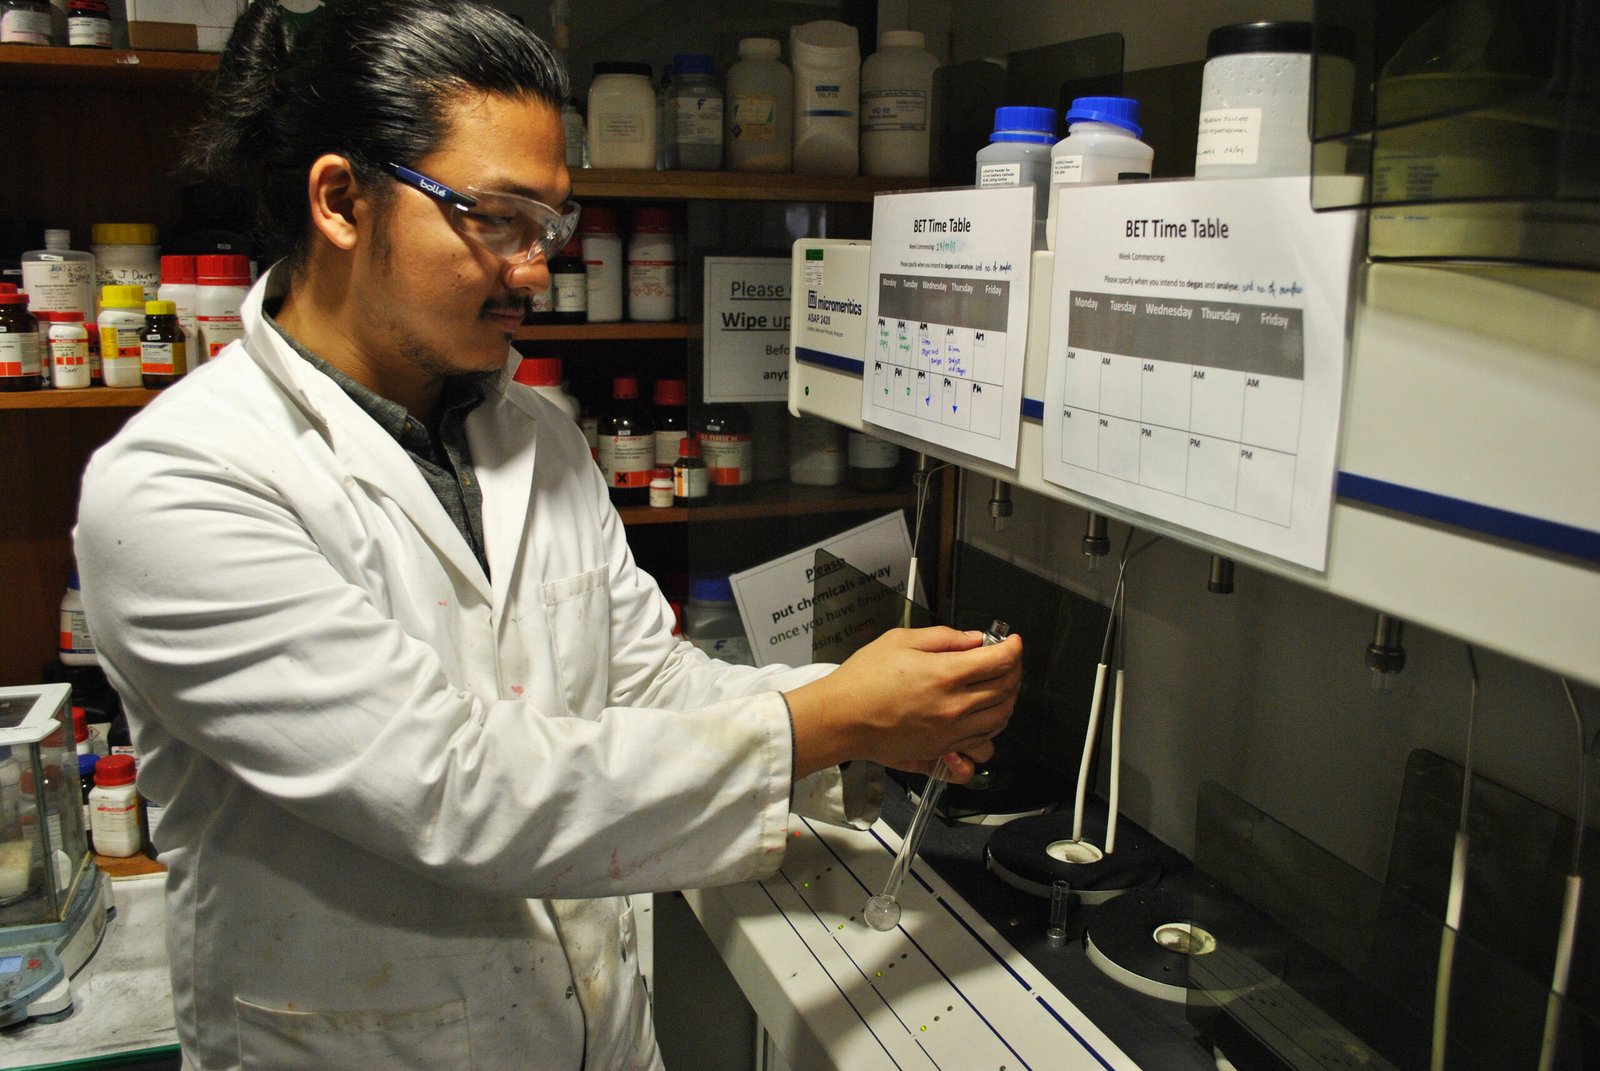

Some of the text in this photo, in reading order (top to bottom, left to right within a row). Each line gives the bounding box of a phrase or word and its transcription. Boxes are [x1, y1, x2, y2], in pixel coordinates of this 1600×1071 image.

[419, 178, 446, 198] bollé
[913, 217, 971, 233] BET Time Table
[1125, 217, 1229, 239] BET Time Table
[1118, 252, 1165, 263] Week Commencing:
[731, 281, 785, 297] Please
[882, 278, 1002, 297] Monday Tuesday Wednesday Thursday Friday
[1104, 275, 1118, 284] Please
[1118, 276, 1134, 286] specify
[1135, 278, 1148, 286] when
[1149, 279, 1159, 287] you
[1160, 279, 1178, 288] intend
[1179, 280, 1186, 288] to
[1186, 280, 1203, 291] degas
[817, 295, 862, 316] micromeritics
[1074, 296, 1289, 330] Monday Tuesday Wednesday Thursday Friday
[722, 312, 791, 329] Wipe up
[808, 313, 831, 325] ASAP 2420
[919, 322, 928, 331] AM
[975, 332, 985, 341] AM
[1067, 352, 1259, 388] AM AM AM AM AM
[895, 368, 903, 378] PM
[918, 371, 926, 379] PM
[944, 378, 952, 388] PM
[972, 383, 982, 394] PM
[1063, 410, 1253, 460] PM PM PM PM PM
[805, 558, 846, 580] Please
[772, 564, 892, 624] put chemicals away
[769, 580, 906, 647] once you have finished
[845, 615, 876, 637] them
